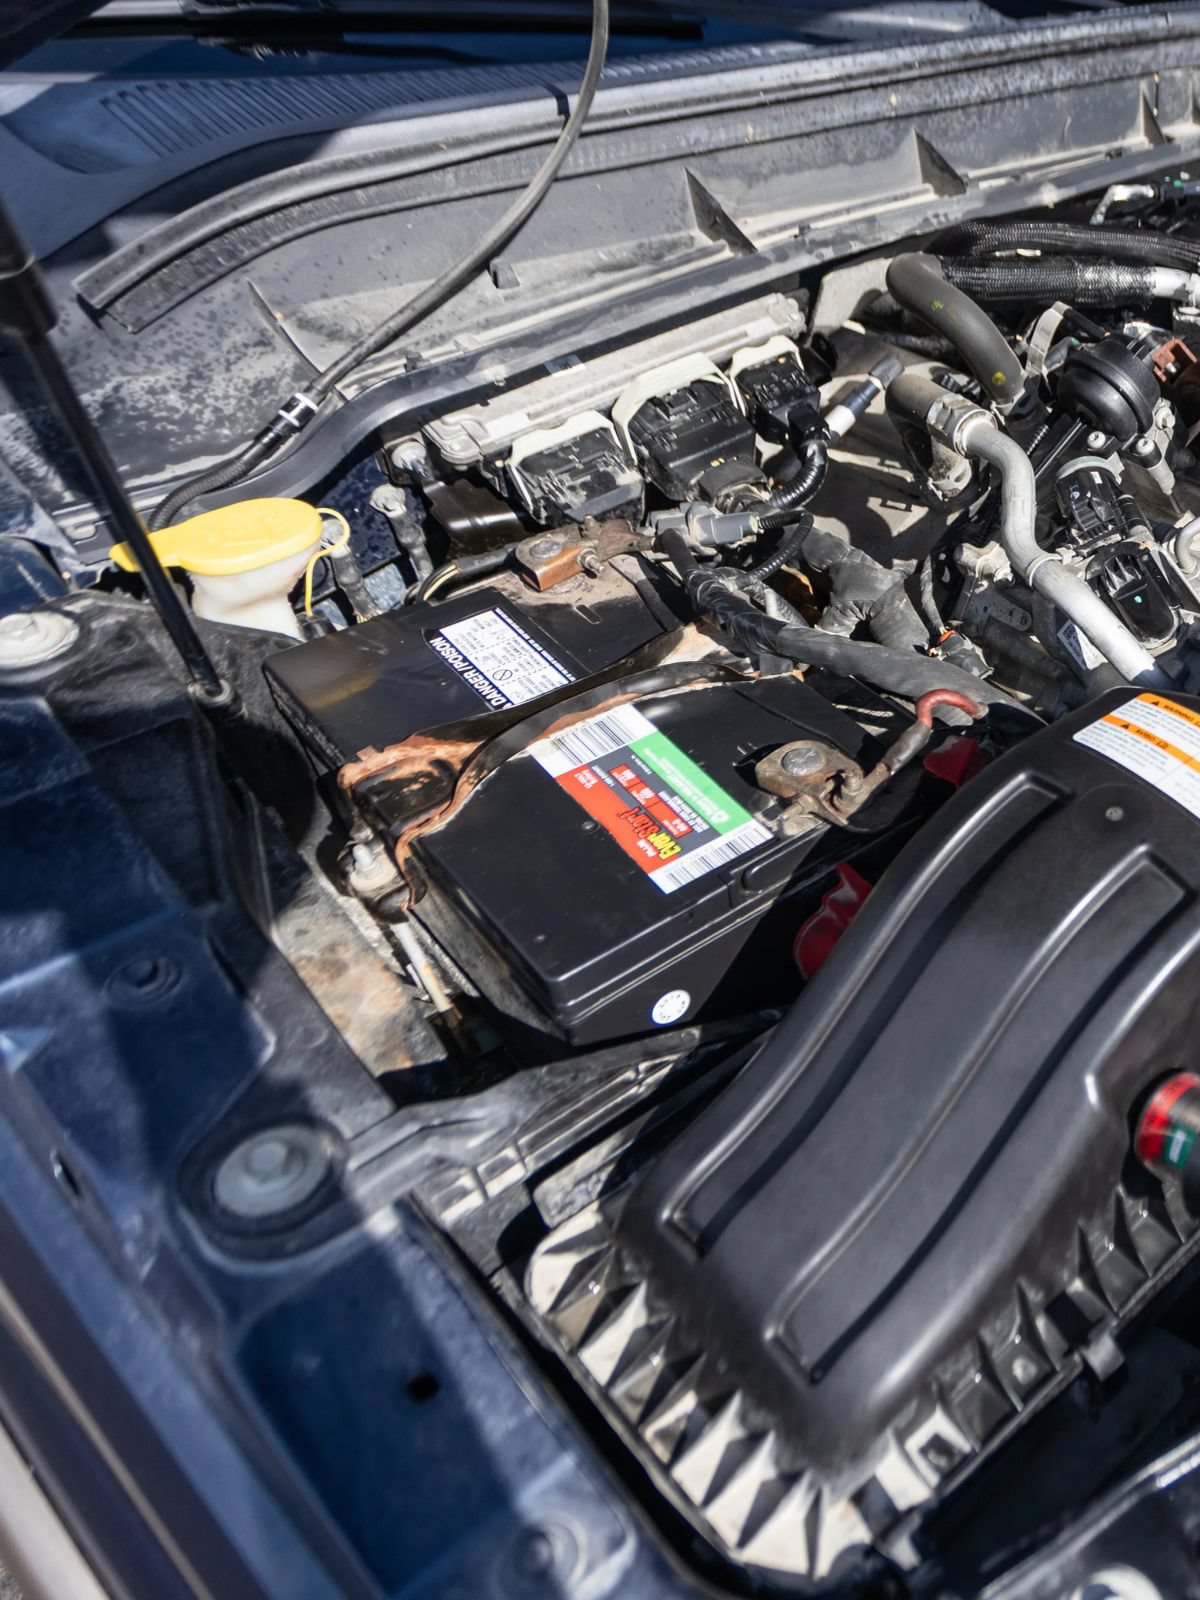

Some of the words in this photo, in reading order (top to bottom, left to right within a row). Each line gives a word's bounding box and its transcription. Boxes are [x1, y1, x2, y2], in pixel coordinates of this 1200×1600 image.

[429, 637, 466, 671] POISON
[463, 671, 503, 706] DANGER
[617, 805, 683, 861] EverStart
